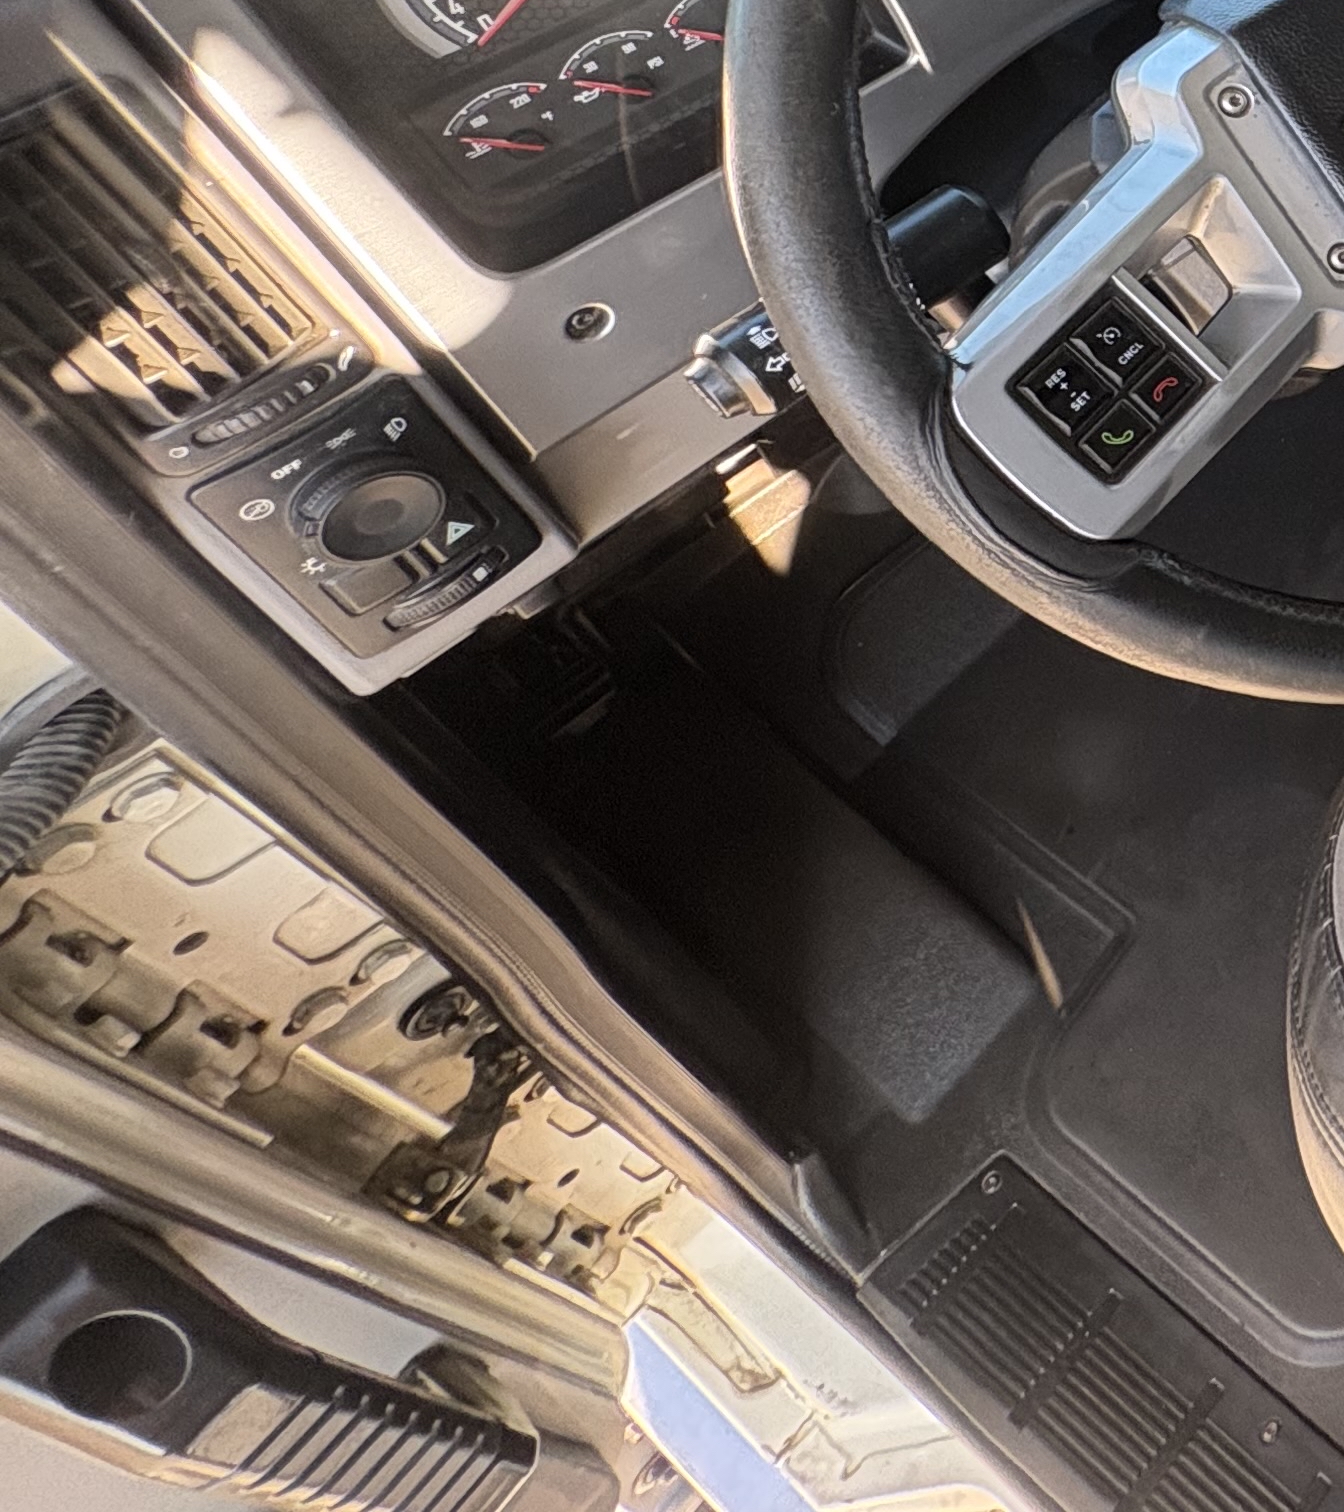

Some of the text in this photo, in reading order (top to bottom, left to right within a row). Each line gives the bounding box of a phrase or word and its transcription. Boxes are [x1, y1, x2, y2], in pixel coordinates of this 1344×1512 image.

[1118, 343, 1144, 365] CNCL
[1045, 368, 1066, 389] RES
[1070, 391, 1091, 412] SET
[270, 458, 302, 480] OFF
